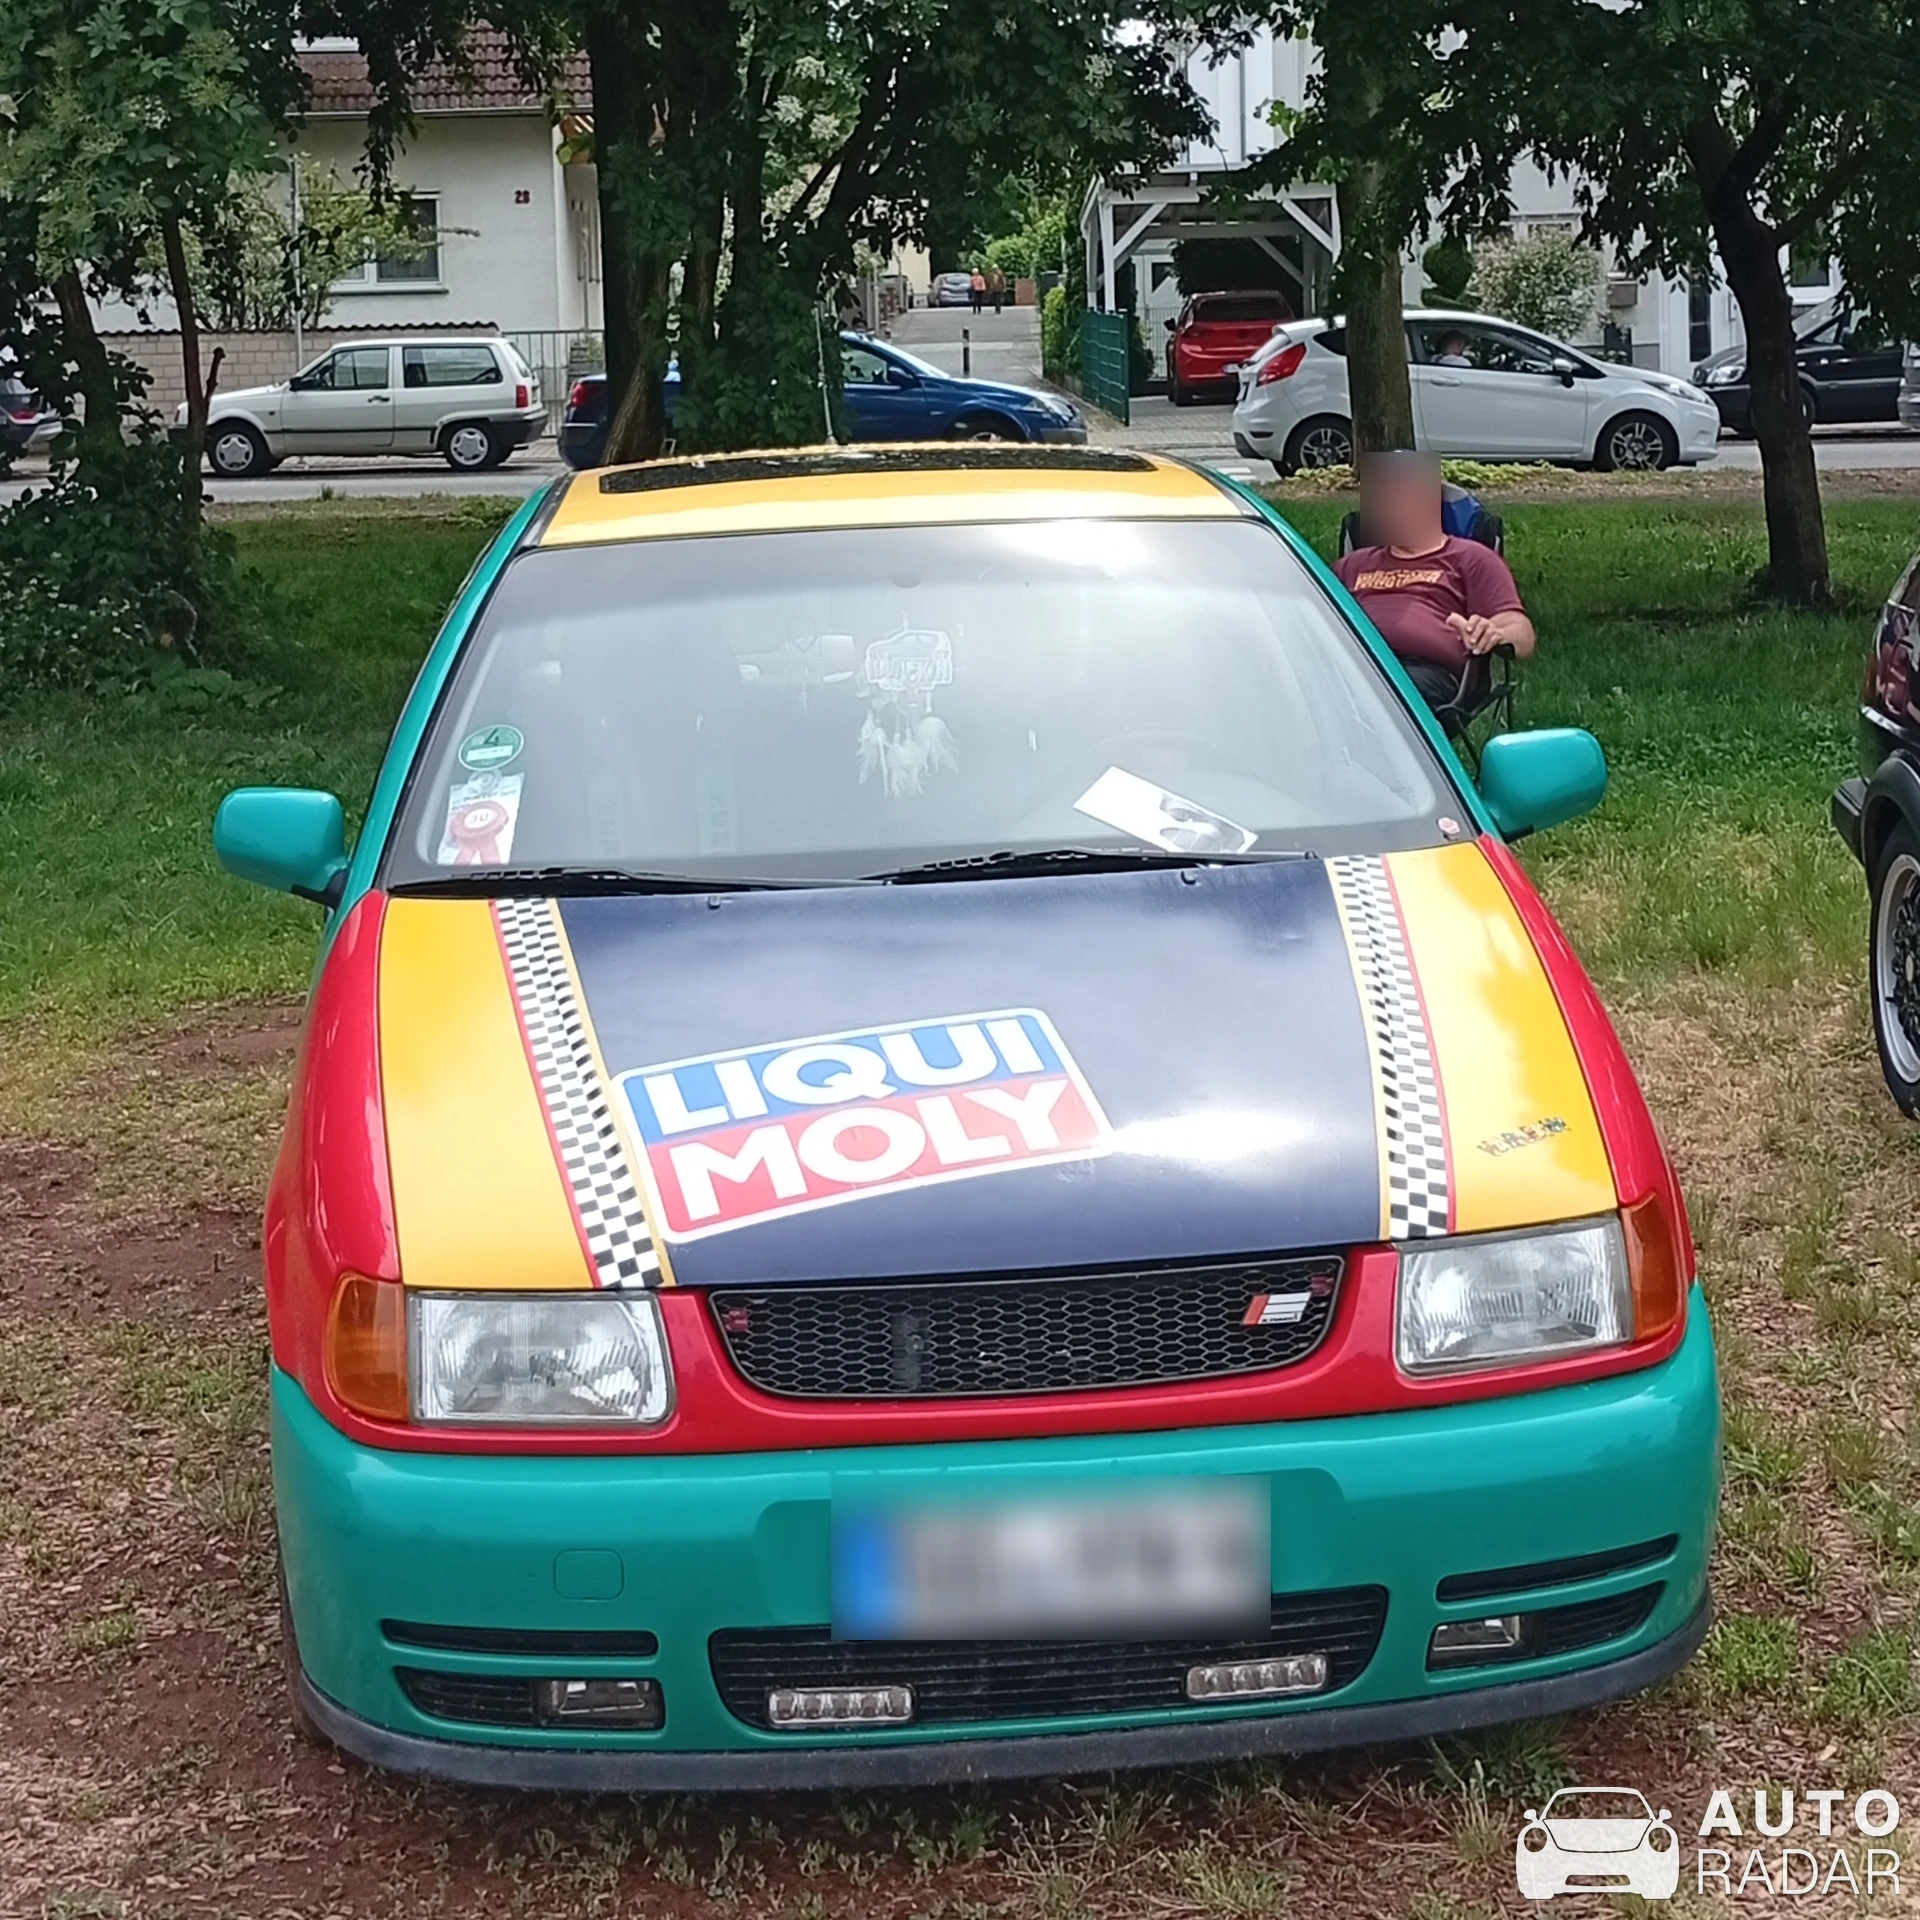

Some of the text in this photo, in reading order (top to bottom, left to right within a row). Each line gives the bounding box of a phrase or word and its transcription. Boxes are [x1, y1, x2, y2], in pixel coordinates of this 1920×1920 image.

[484, 728, 500, 746] 4
[644, 1019, 1045, 1135] LIQUI
[669, 1079, 1069, 1221] MOLY
